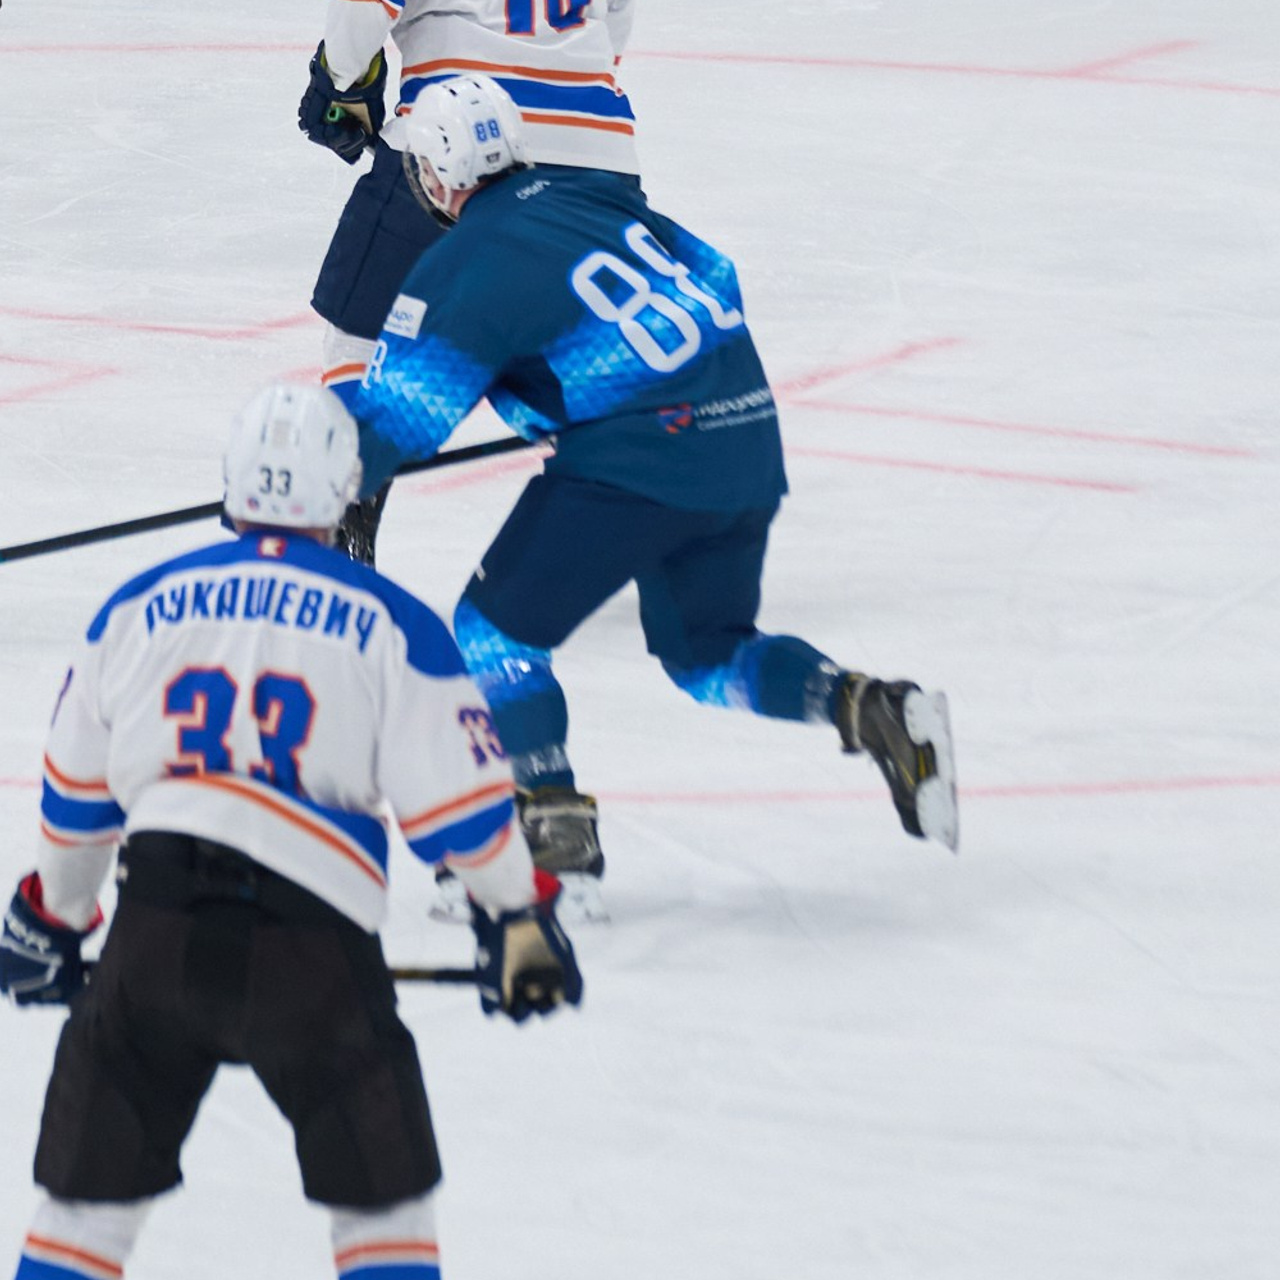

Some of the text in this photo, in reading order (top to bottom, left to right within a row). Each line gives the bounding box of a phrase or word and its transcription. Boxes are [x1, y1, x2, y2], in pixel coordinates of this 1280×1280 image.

[475, 119, 501, 142] 88
[258, 466, 293, 498] 33
[145, 577, 378, 655] ЛУКАШЕВИЧ
[163, 666, 318, 796] 33
